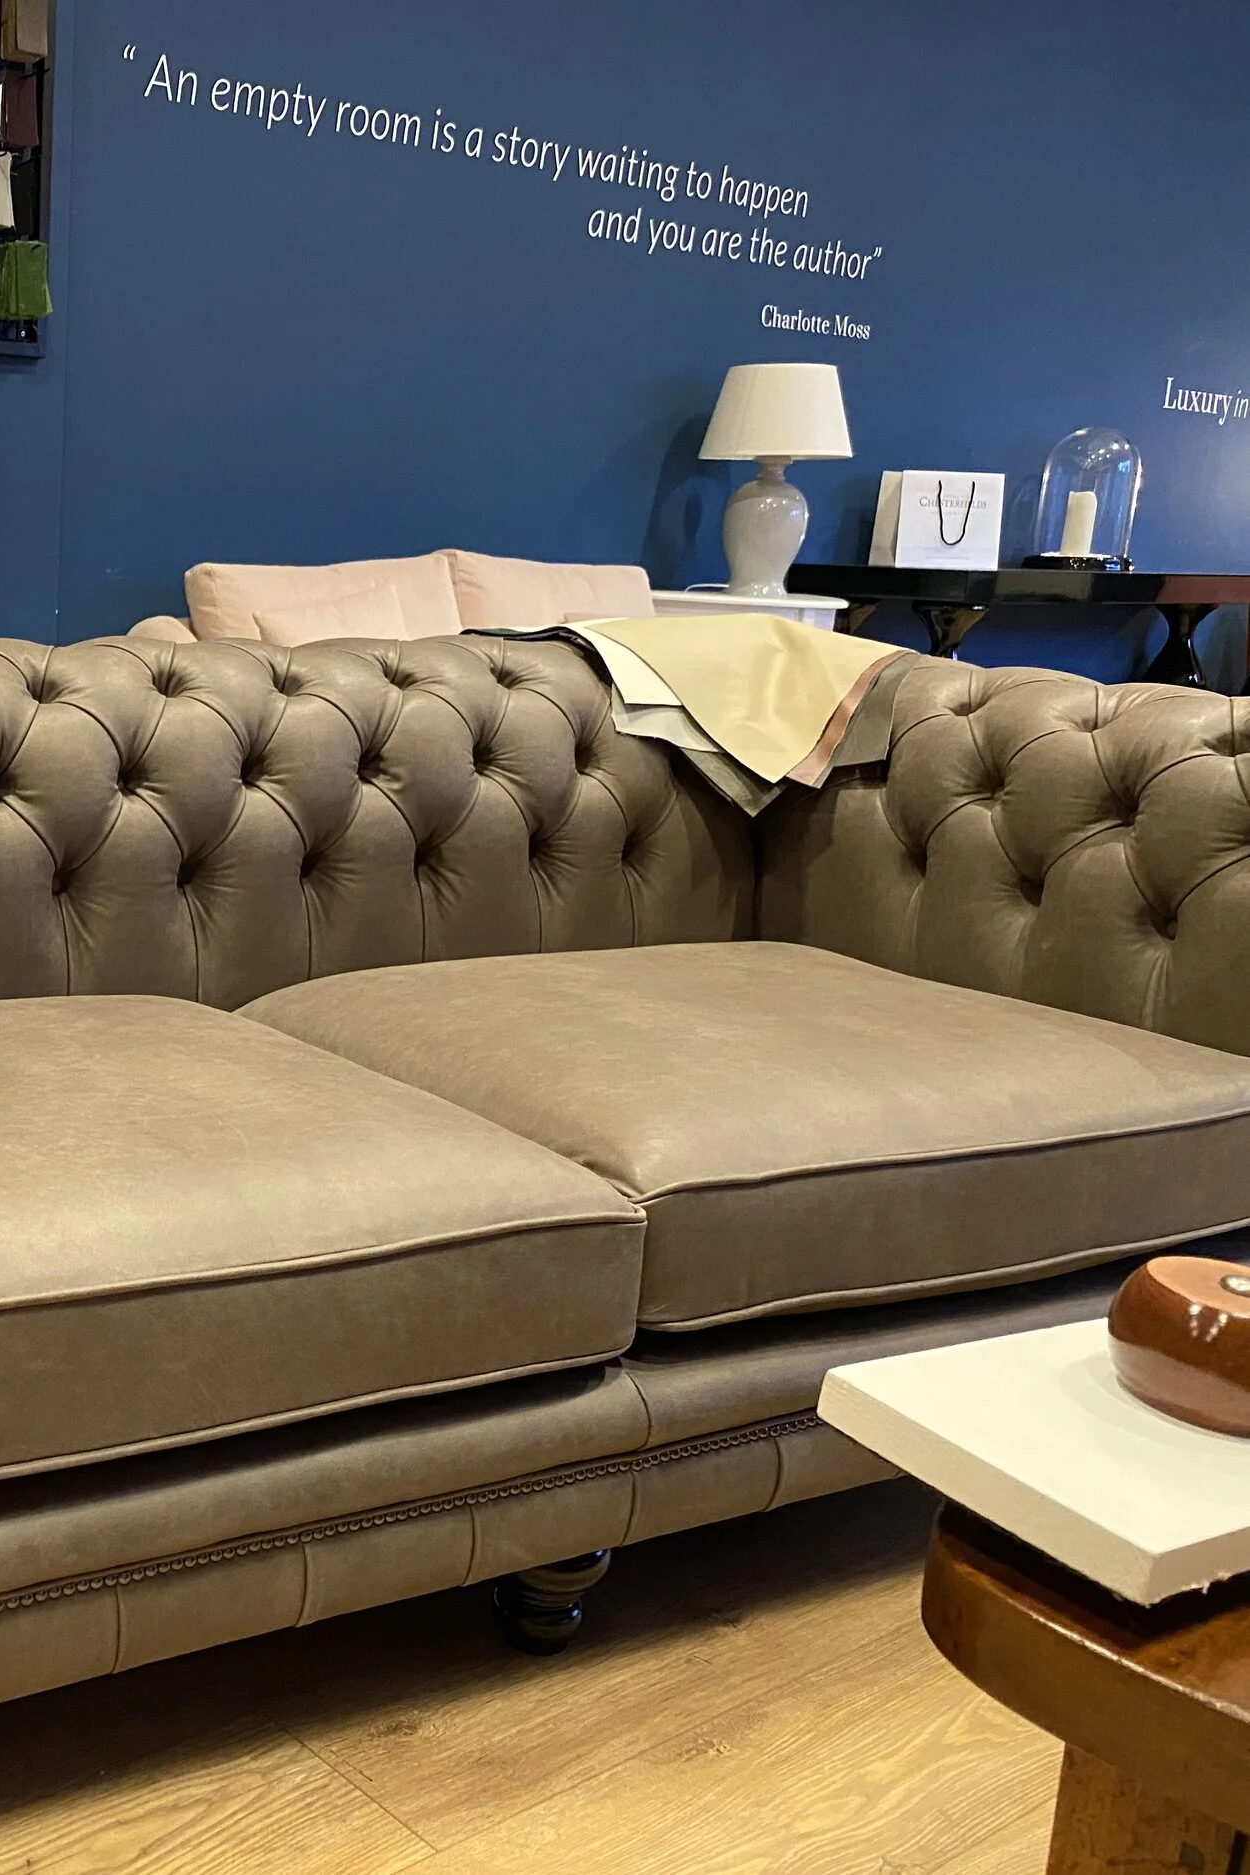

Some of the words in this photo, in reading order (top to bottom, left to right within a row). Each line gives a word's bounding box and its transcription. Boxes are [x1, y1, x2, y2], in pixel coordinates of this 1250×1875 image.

[211, 78, 327, 137] empty
[335, 101, 421, 147] room
[431, 108, 457, 153] is
[464, 127, 484, 158] a
[491, 126, 571, 182] story
[578, 145, 680, 202] waiting
[686, 161, 712, 200] to
[718, 164, 809, 220] happen
[588, 207, 642, 244] and
[647, 218, 696, 255] you
[701, 228, 743, 260] are
[749, 227, 788, 267] the
[761, 304, 830, 335] Charlotte
[833, 314, 871, 340] Moss
[1162, 376, 1233, 426] Luxury
[1233, 389, 1249, 419] in
